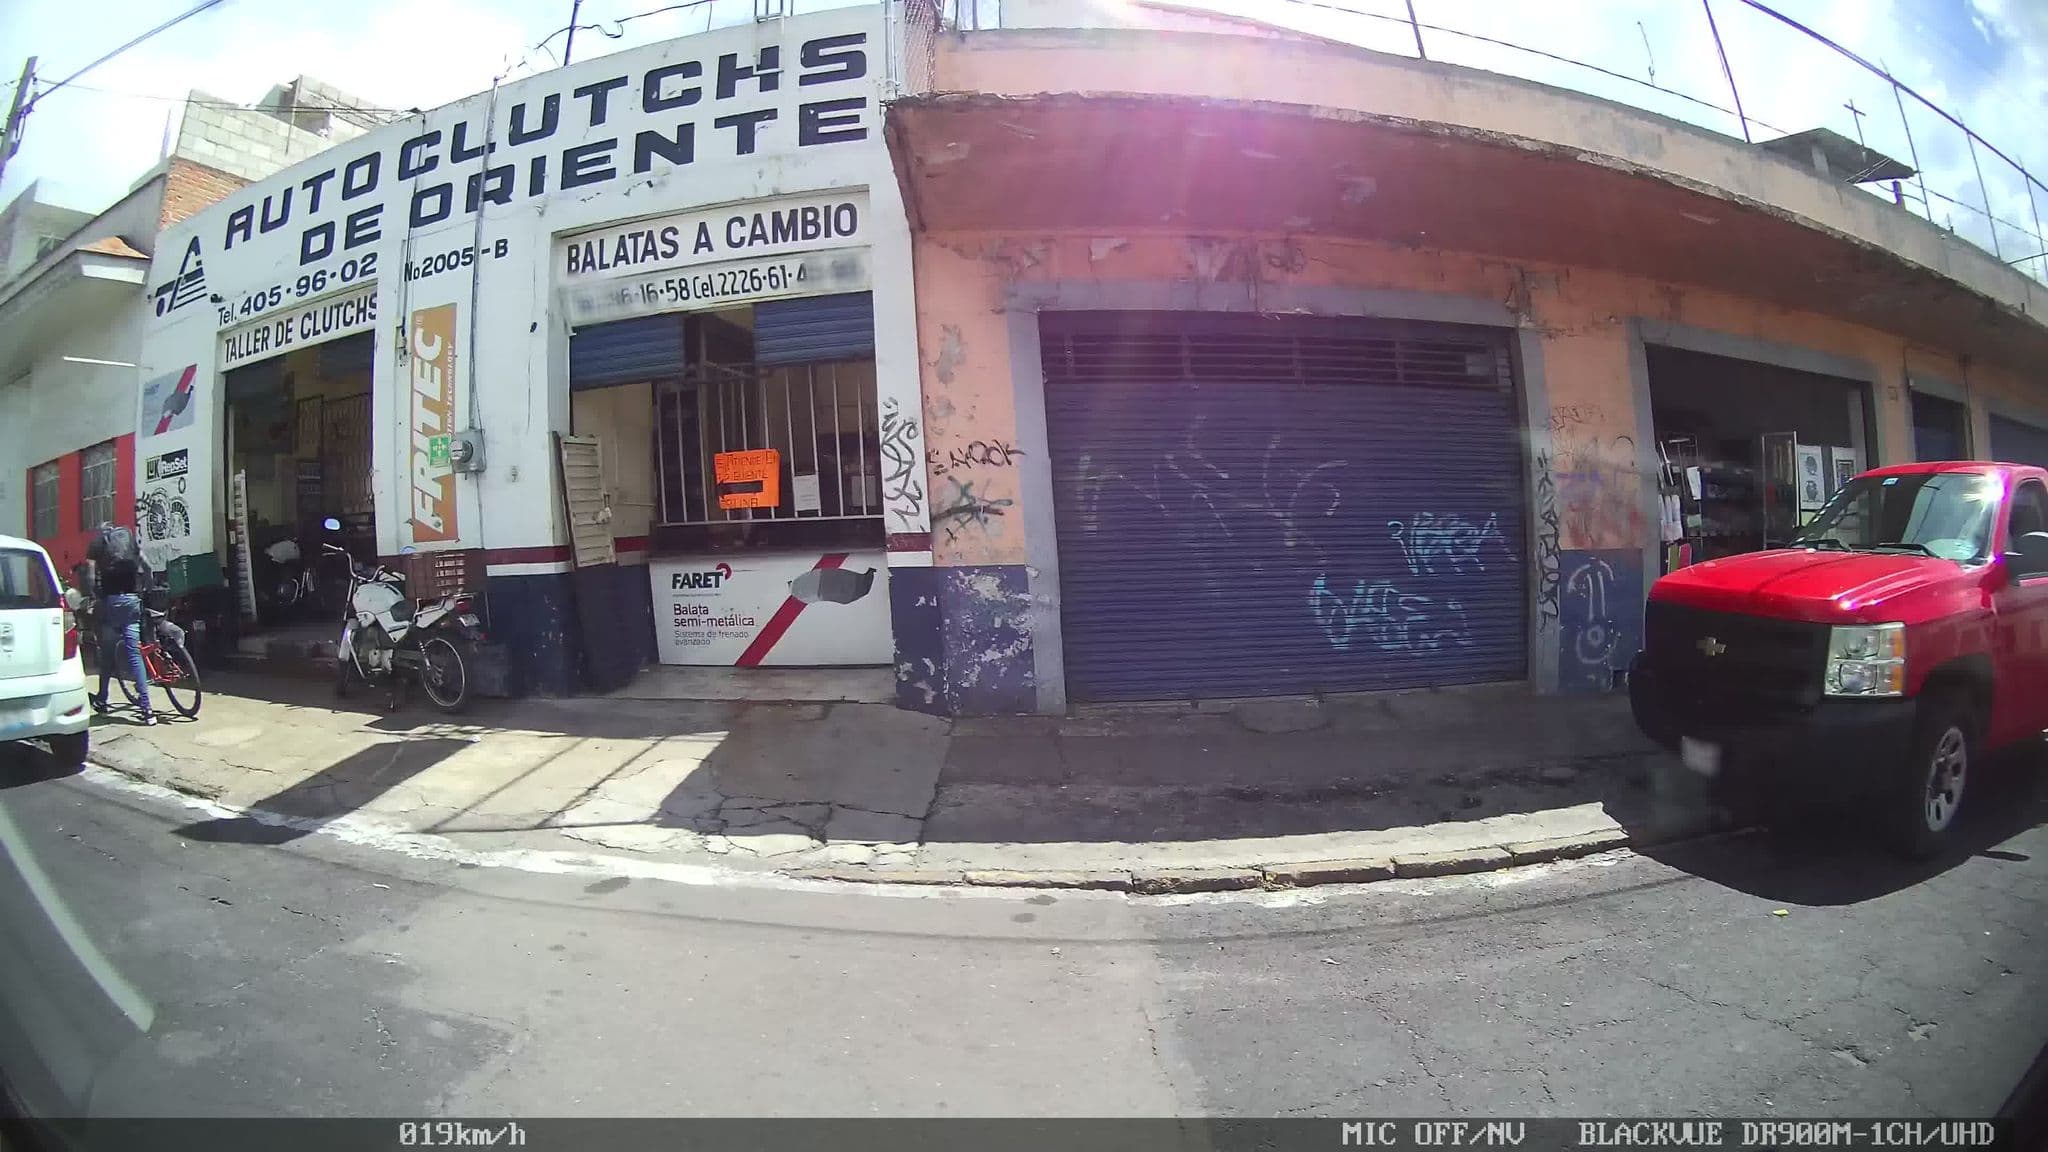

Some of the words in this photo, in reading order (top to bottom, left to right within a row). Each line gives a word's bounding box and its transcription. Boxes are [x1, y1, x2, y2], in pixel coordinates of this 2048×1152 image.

[299, 203, 384, 266] DE
[409, 97, 867, 229] ORIENTE
[566, 226, 680, 275] BALATAS
[693, 221, 714, 255] A
[725, 202, 858, 249] CAMBIO
[218, 303, 237, 327] Tel.
[225, 325, 271, 363] TALLER
[275, 318, 294, 348] DE
[300, 292, 378, 340] CLUTCHS
[413, 327, 450, 534] FRITEC
[671, 571, 724, 589] FARET
[673, 603, 709, 616] Balata
[674, 614, 755, 627] semi-metálica
[674, 630, 704, 638] Sistema
[706, 630, 717, 638] de
[719, 630, 749, 639] frenado
[675, 638, 711, 646] avanzado
